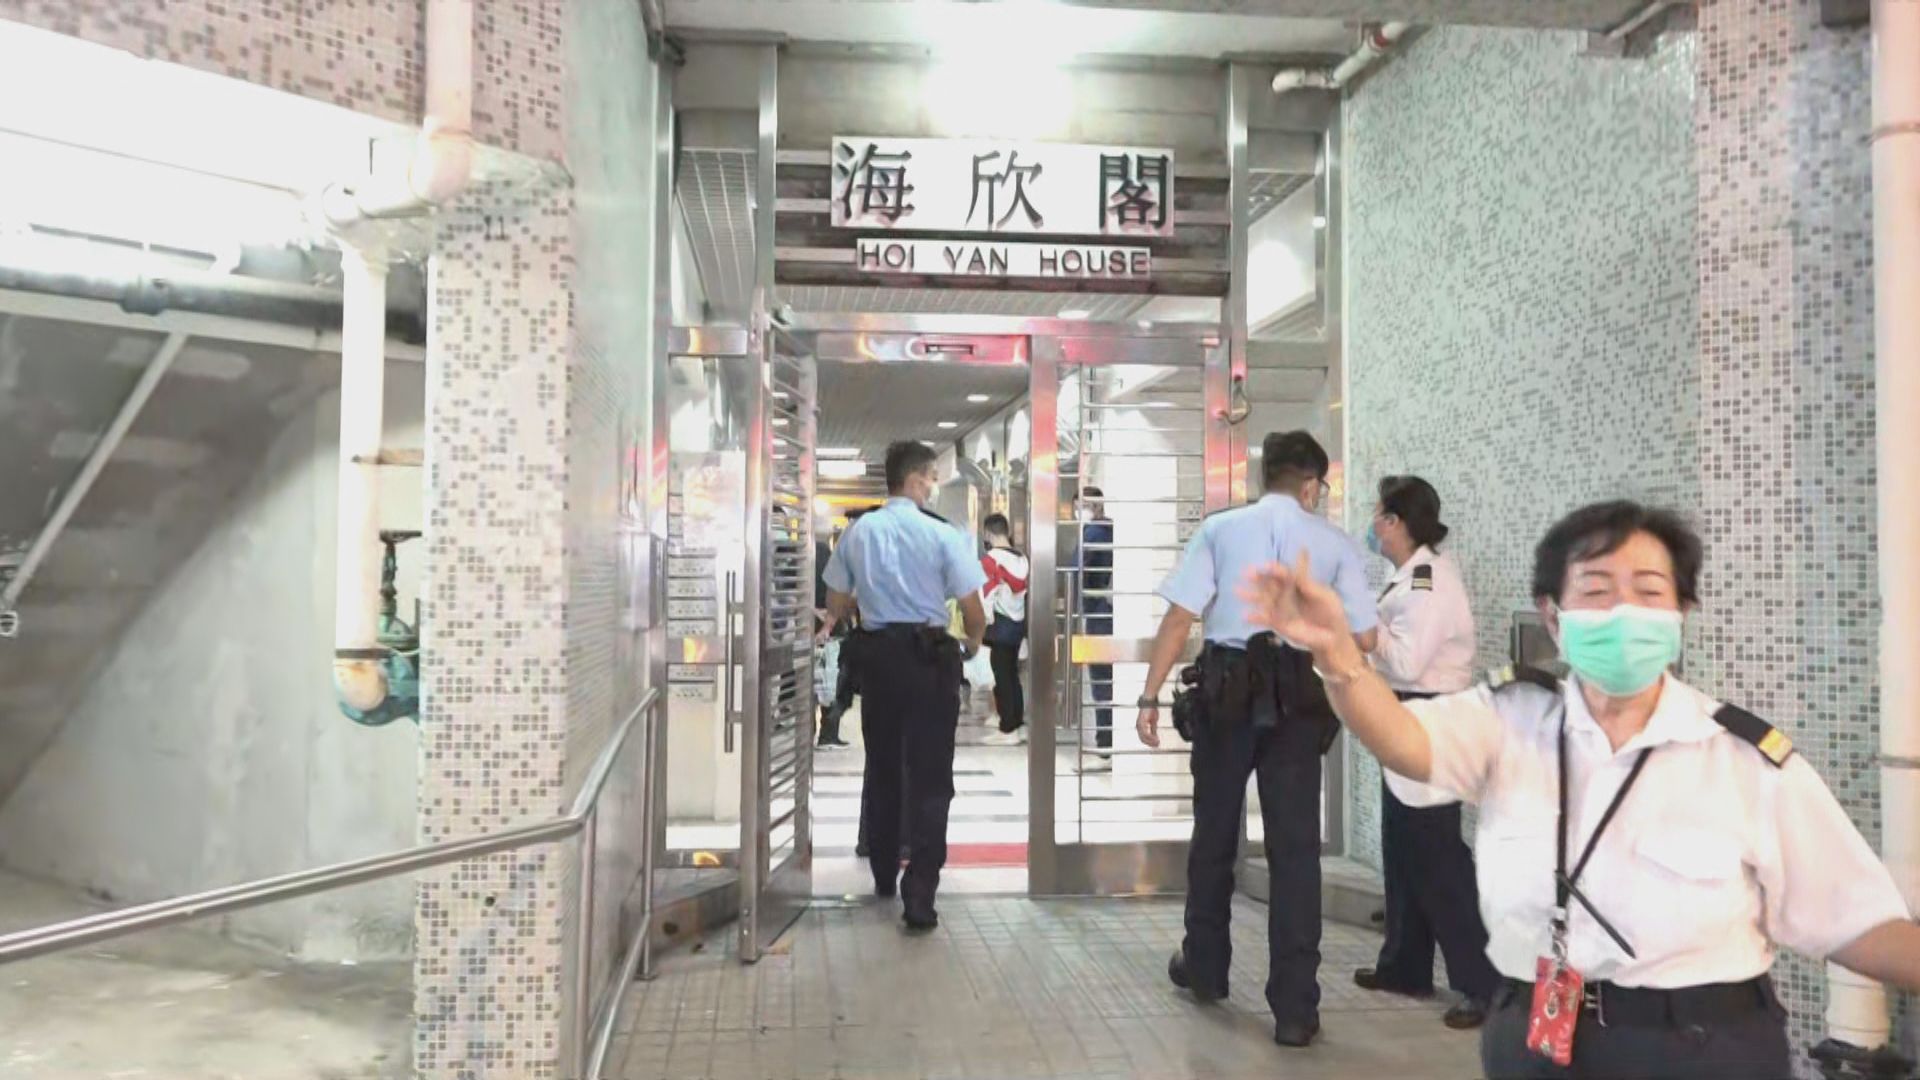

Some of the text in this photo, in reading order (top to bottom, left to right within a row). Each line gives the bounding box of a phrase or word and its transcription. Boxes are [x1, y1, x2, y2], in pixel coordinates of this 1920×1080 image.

[835, 142, 1169, 231] 海欣閣
[861, 243, 1149, 275] HOI YAN HOUSE
